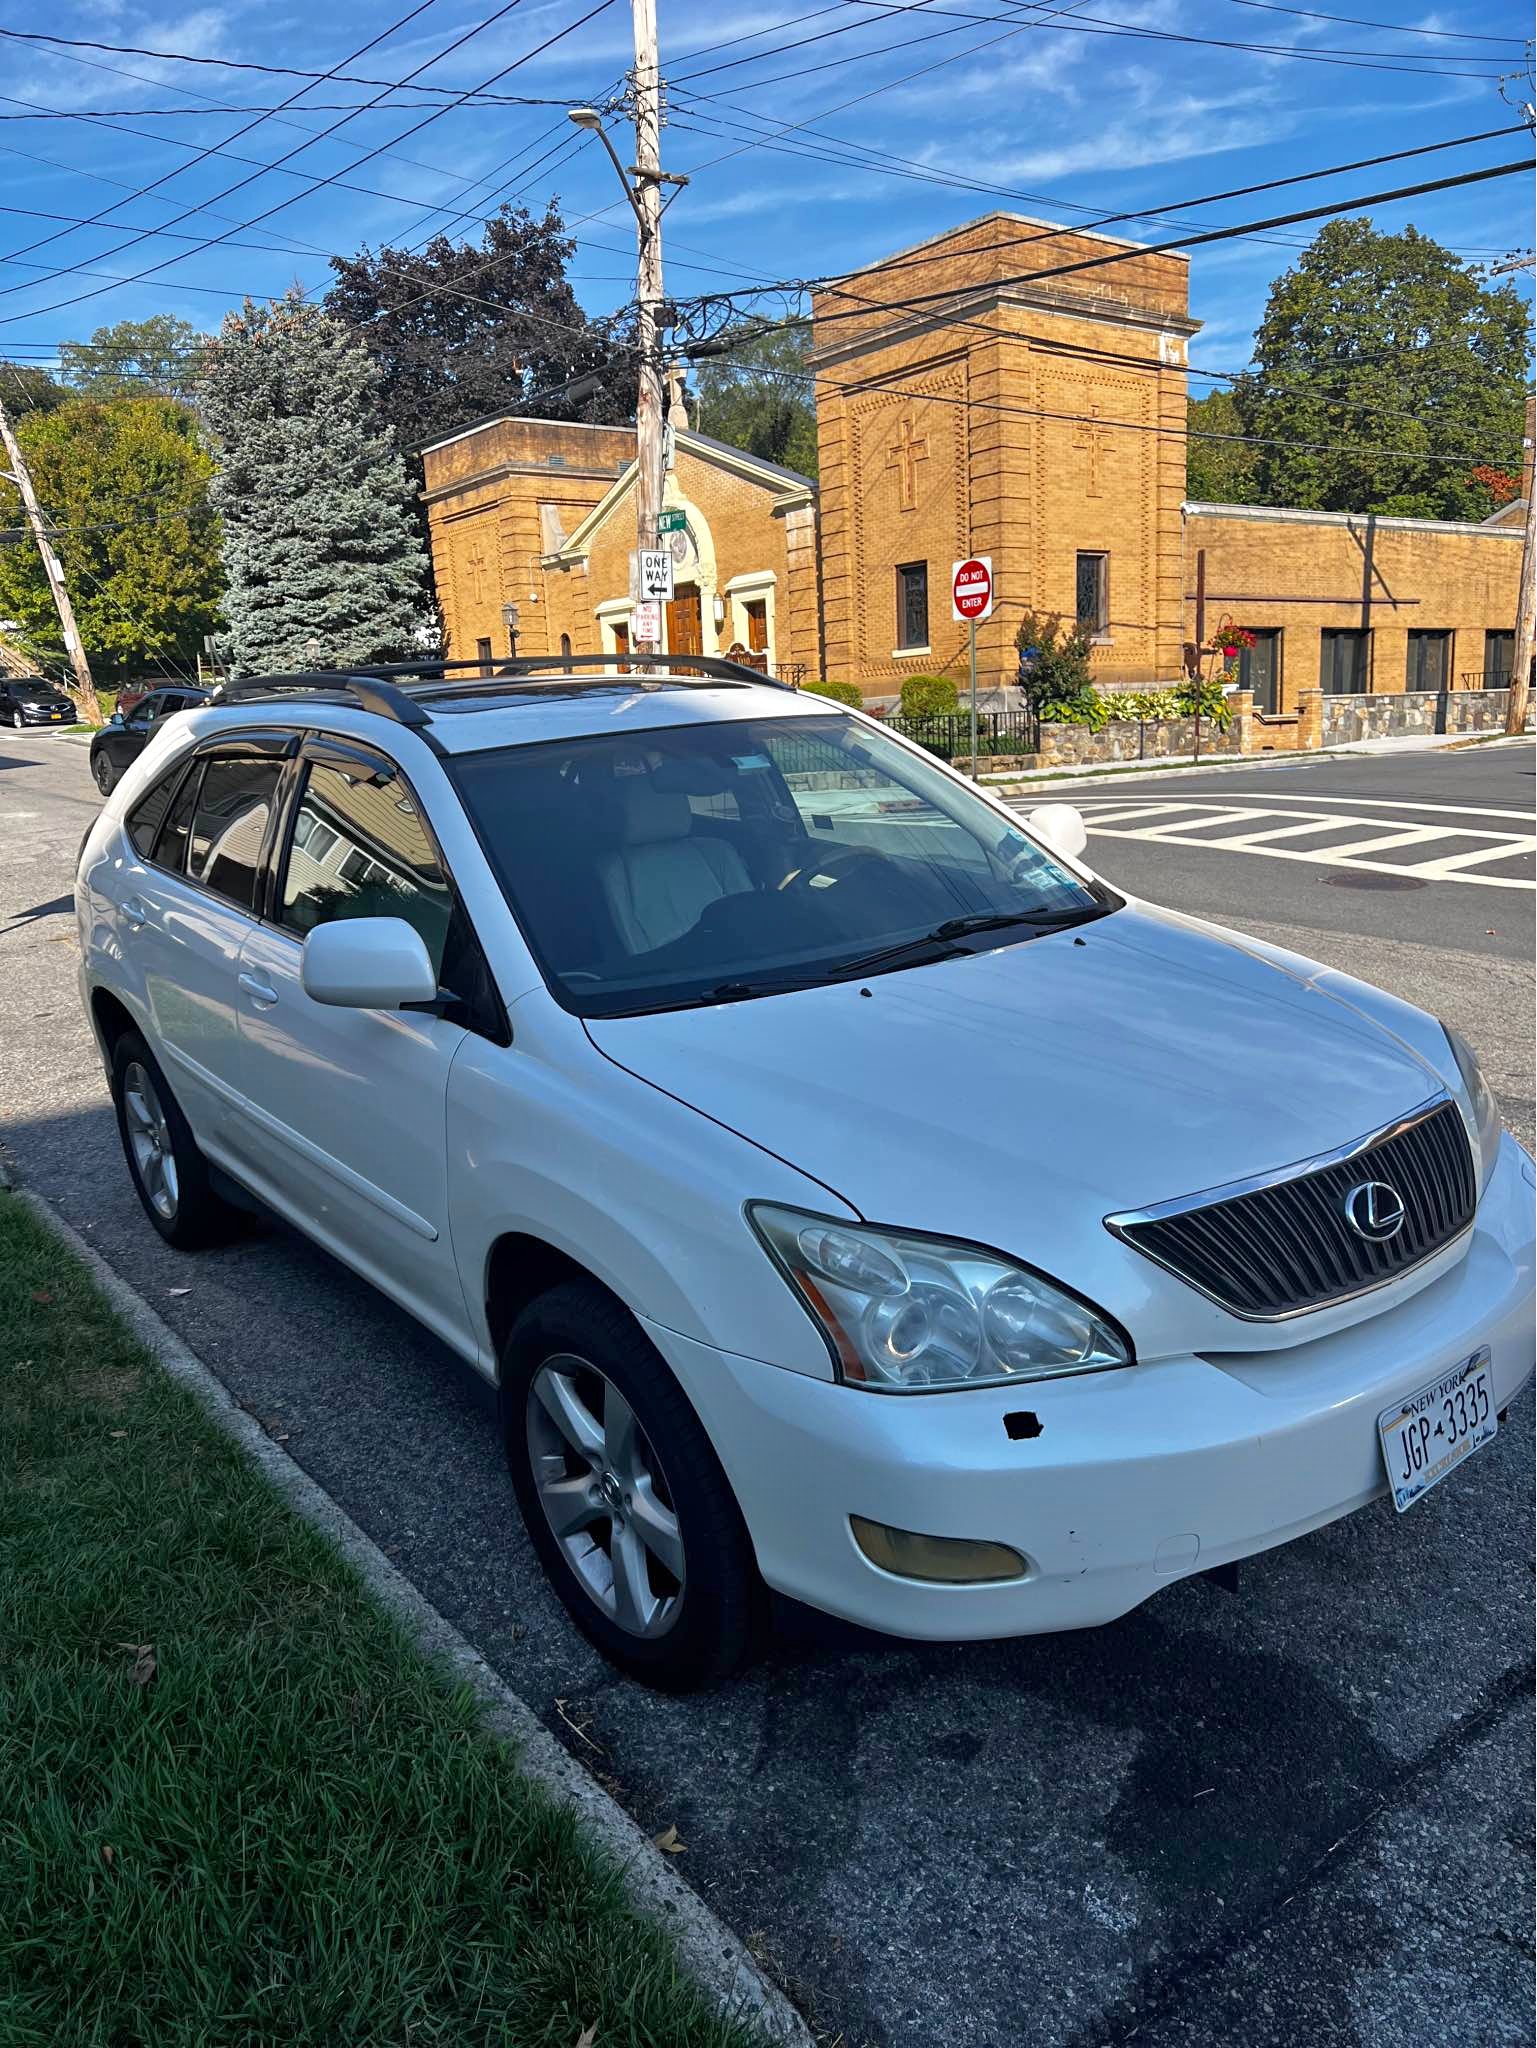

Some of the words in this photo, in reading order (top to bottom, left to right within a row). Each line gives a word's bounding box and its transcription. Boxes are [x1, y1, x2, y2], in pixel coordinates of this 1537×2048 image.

[659, 515, 671, 530] NEW
[646, 557, 668, 569] ONE
[646, 570, 668, 582] WAY
[960, 573, 970, 582] DO
[970, 570, 983, 580] NOT
[962, 597, 982, 608] ENTER
[1411, 1389, 1436, 1418] NEW
[1439, 1371, 1466, 1397] YORK
[1401, 1416, 1430, 1480] JGP
[1443, 1374, 1489, 1444] 3335
